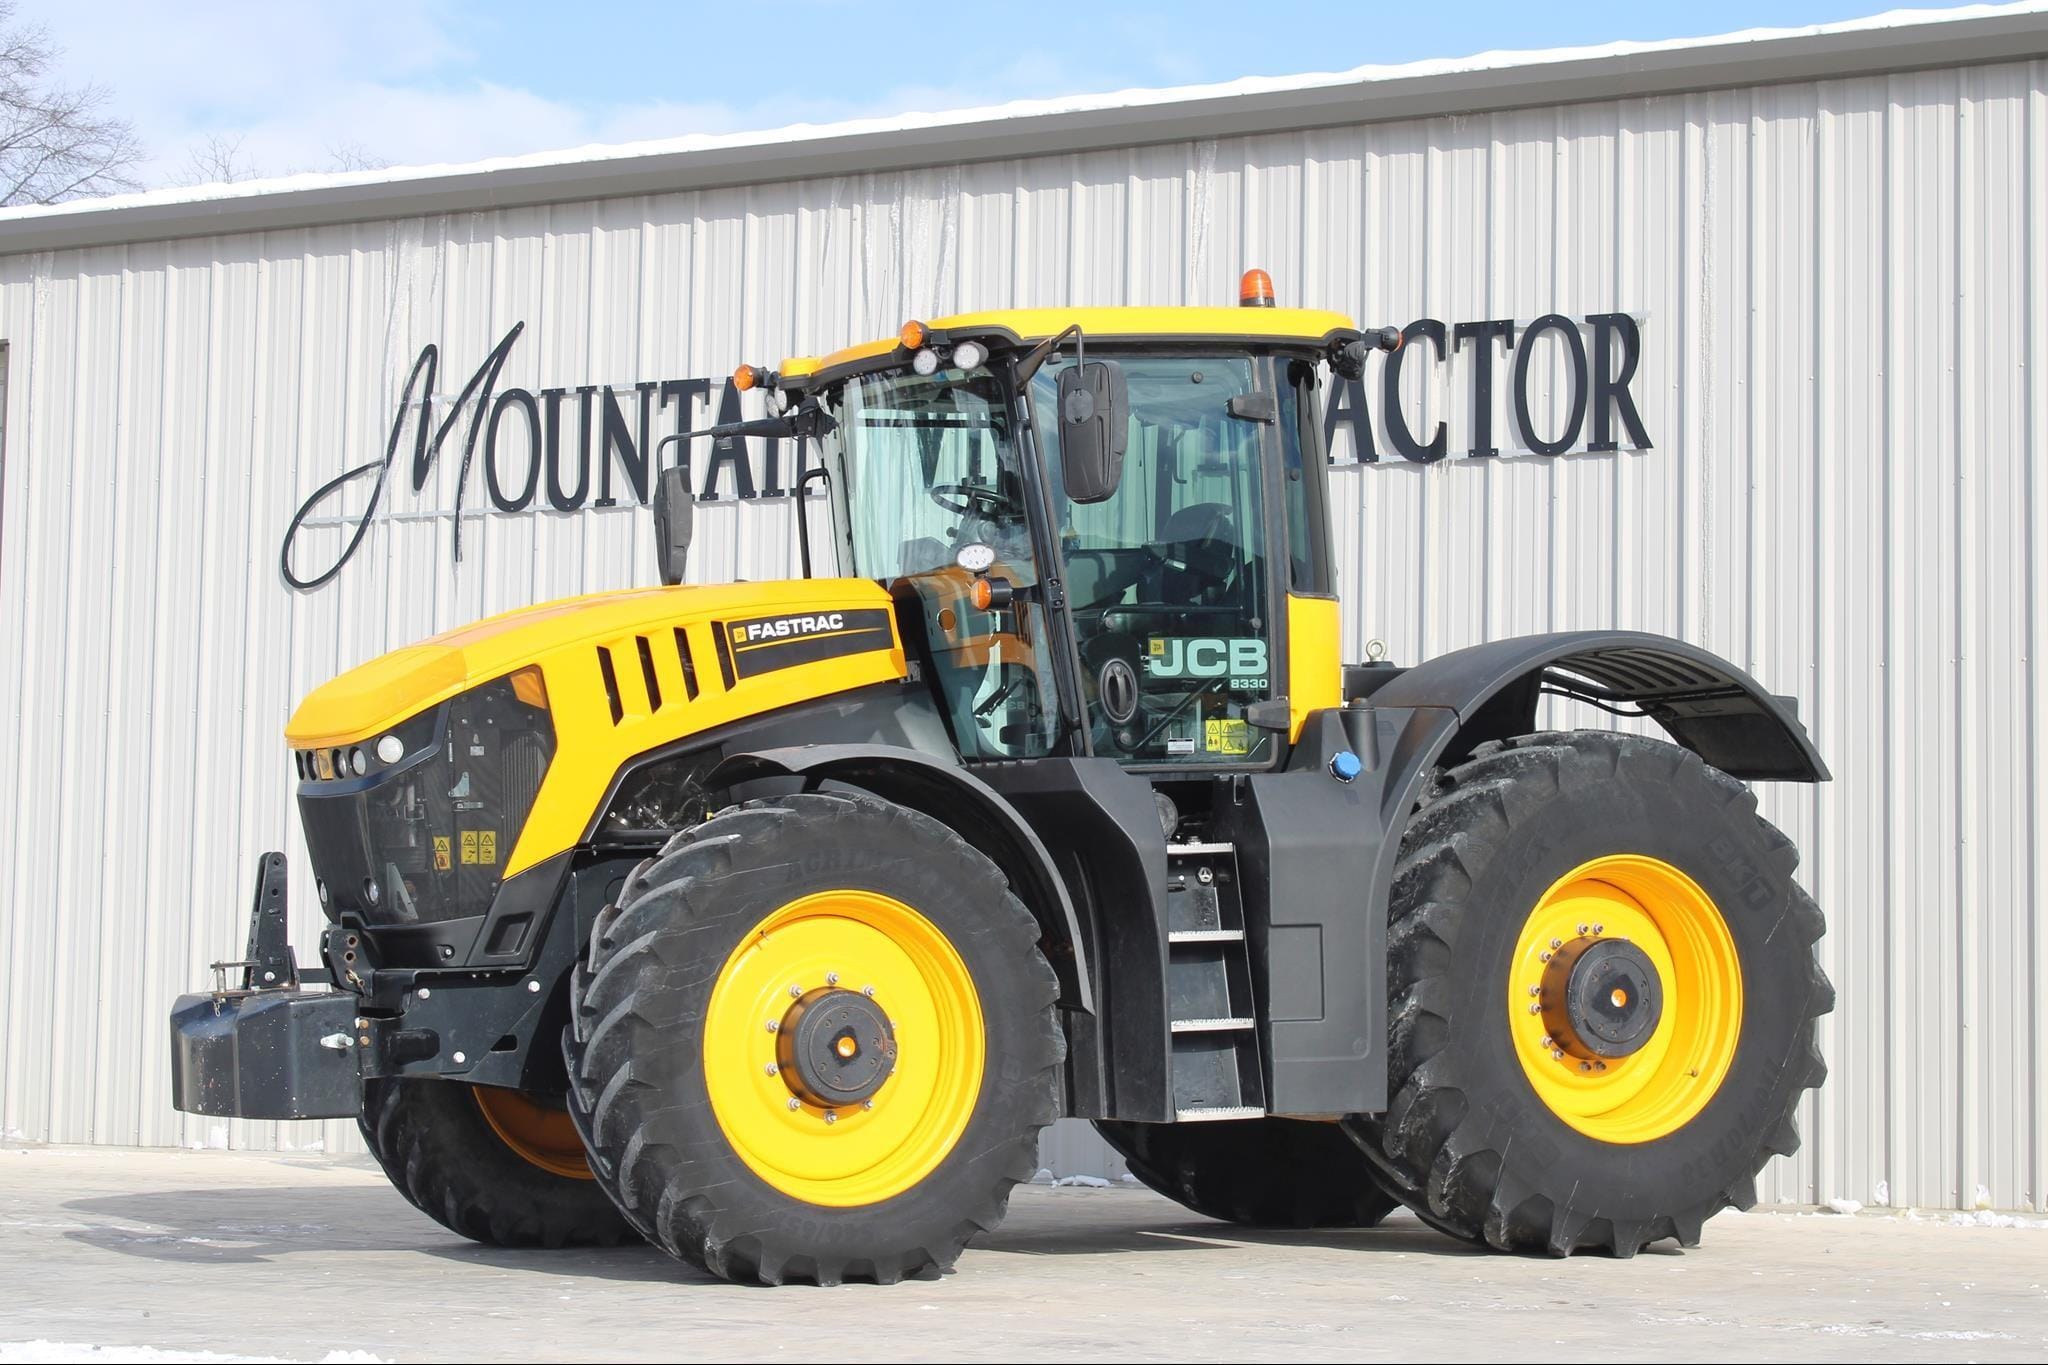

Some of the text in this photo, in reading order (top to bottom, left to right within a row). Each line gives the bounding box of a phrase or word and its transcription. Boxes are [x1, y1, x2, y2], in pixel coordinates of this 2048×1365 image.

[281, 313, 1652, 589] MOUNTAI ACTOR
[748, 613, 844, 641] FASTRAC
[1150, 639, 1268, 676] JCB
[1230, 678, 1268, 689] 8330
[1708, 834, 1775, 909] BKT
